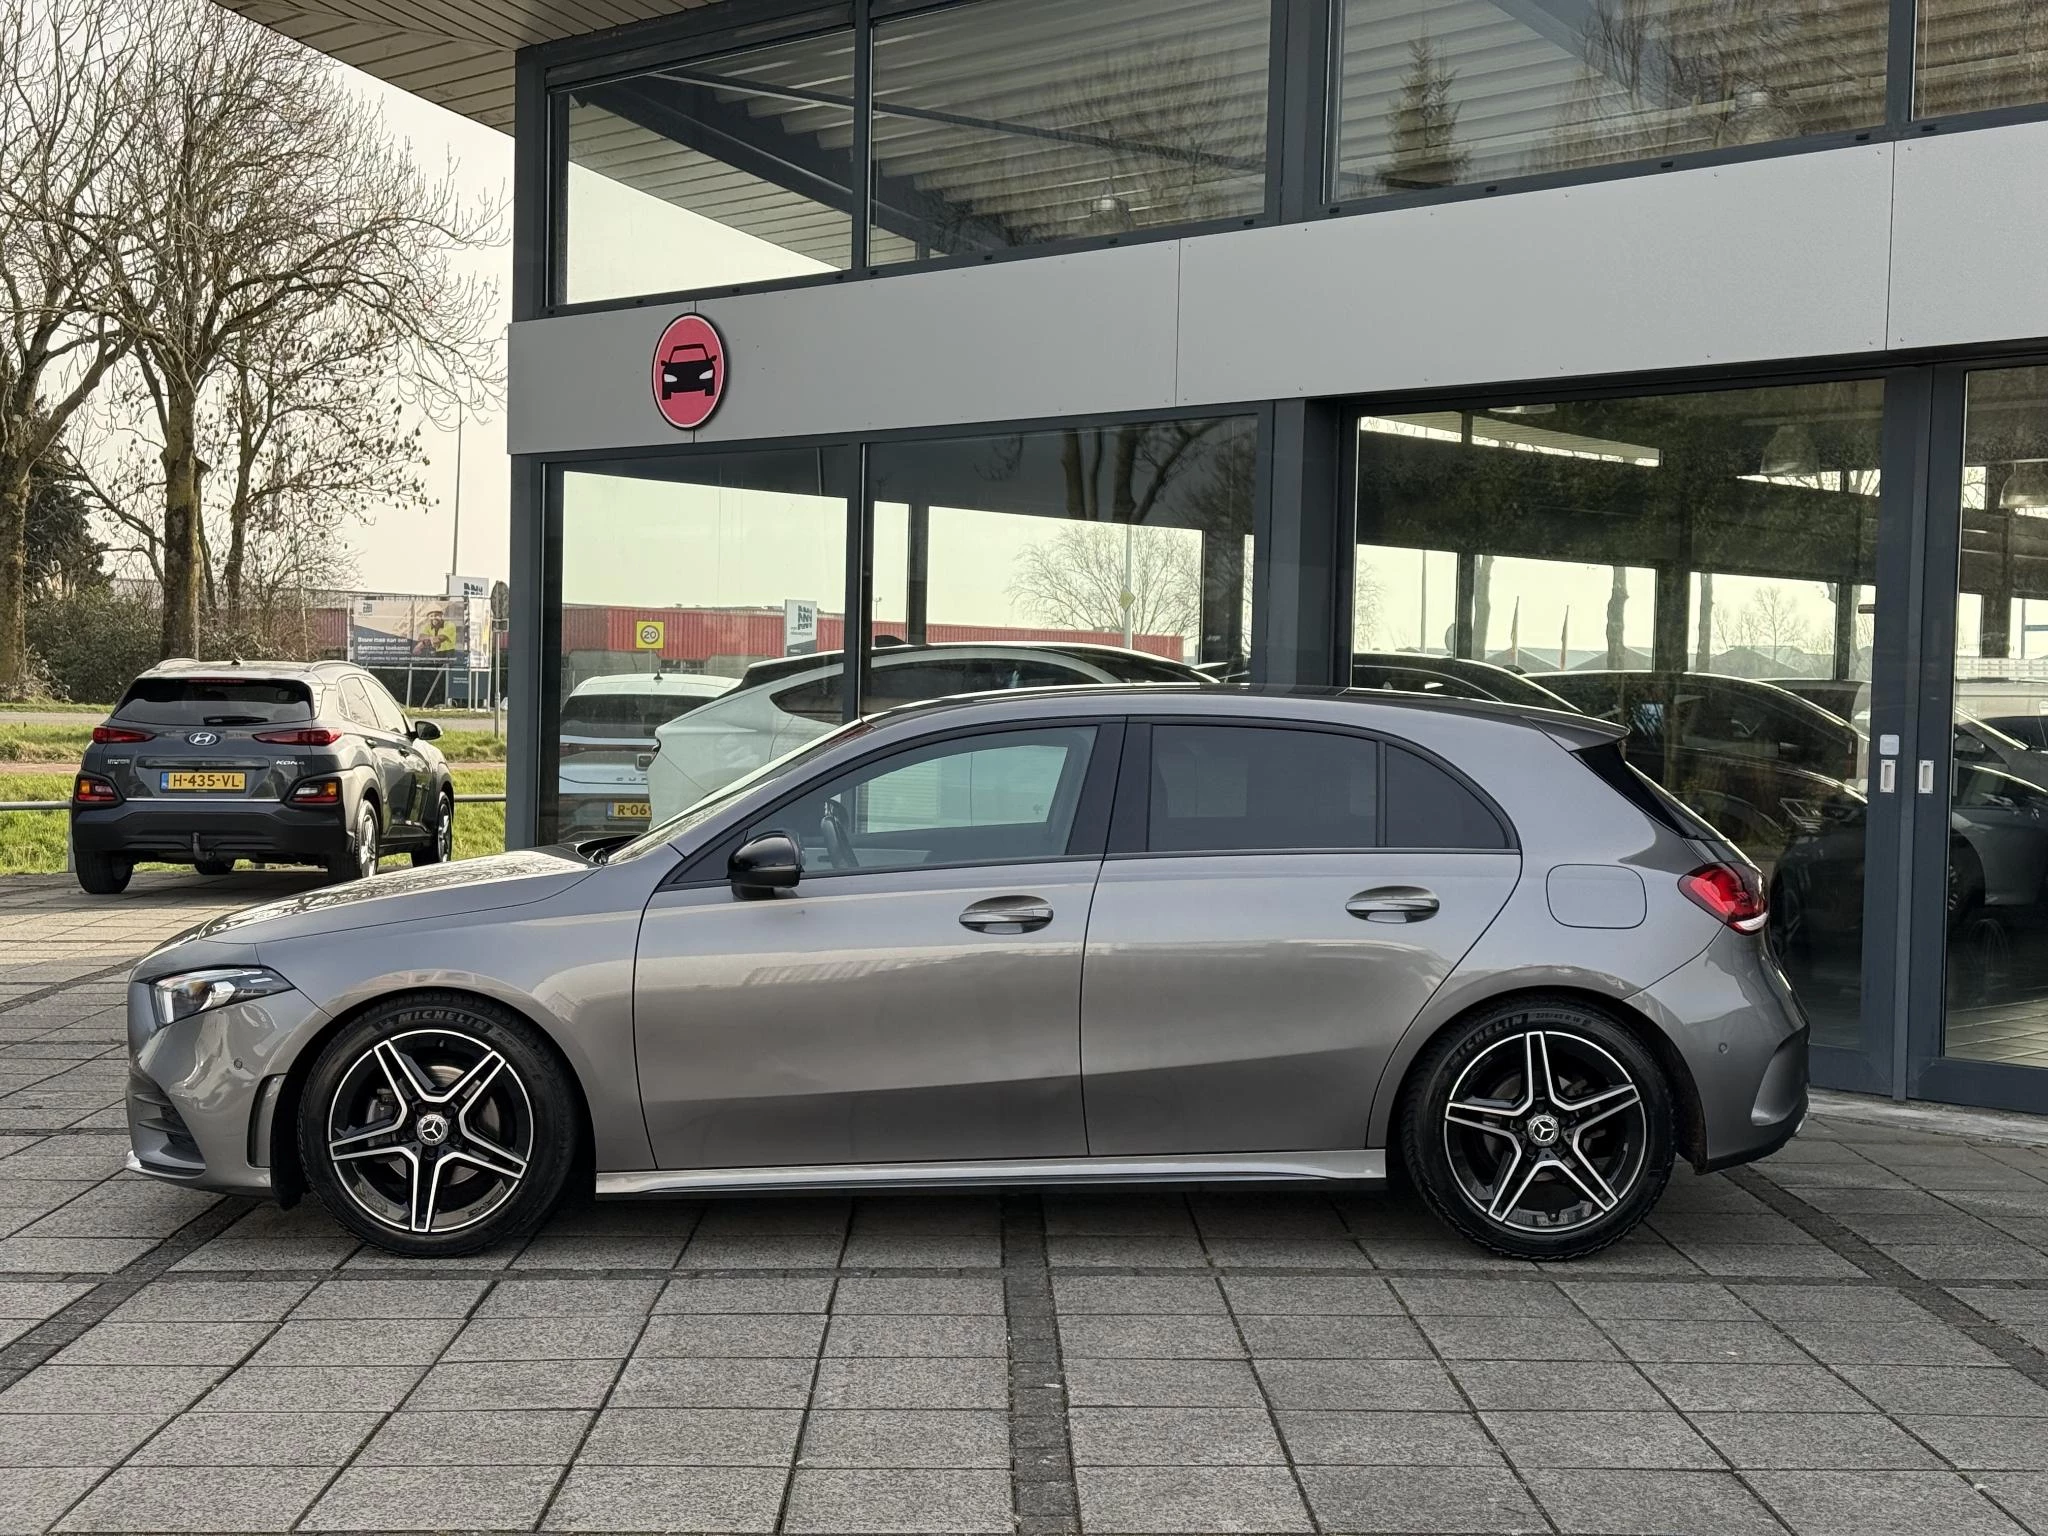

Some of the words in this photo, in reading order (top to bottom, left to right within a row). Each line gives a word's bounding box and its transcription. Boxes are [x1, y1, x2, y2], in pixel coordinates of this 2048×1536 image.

[643, 630, 657, 640] 20
[172, 774, 240, 788] H-435-VL
[398, 1010, 491, 1031] MICHELIN
